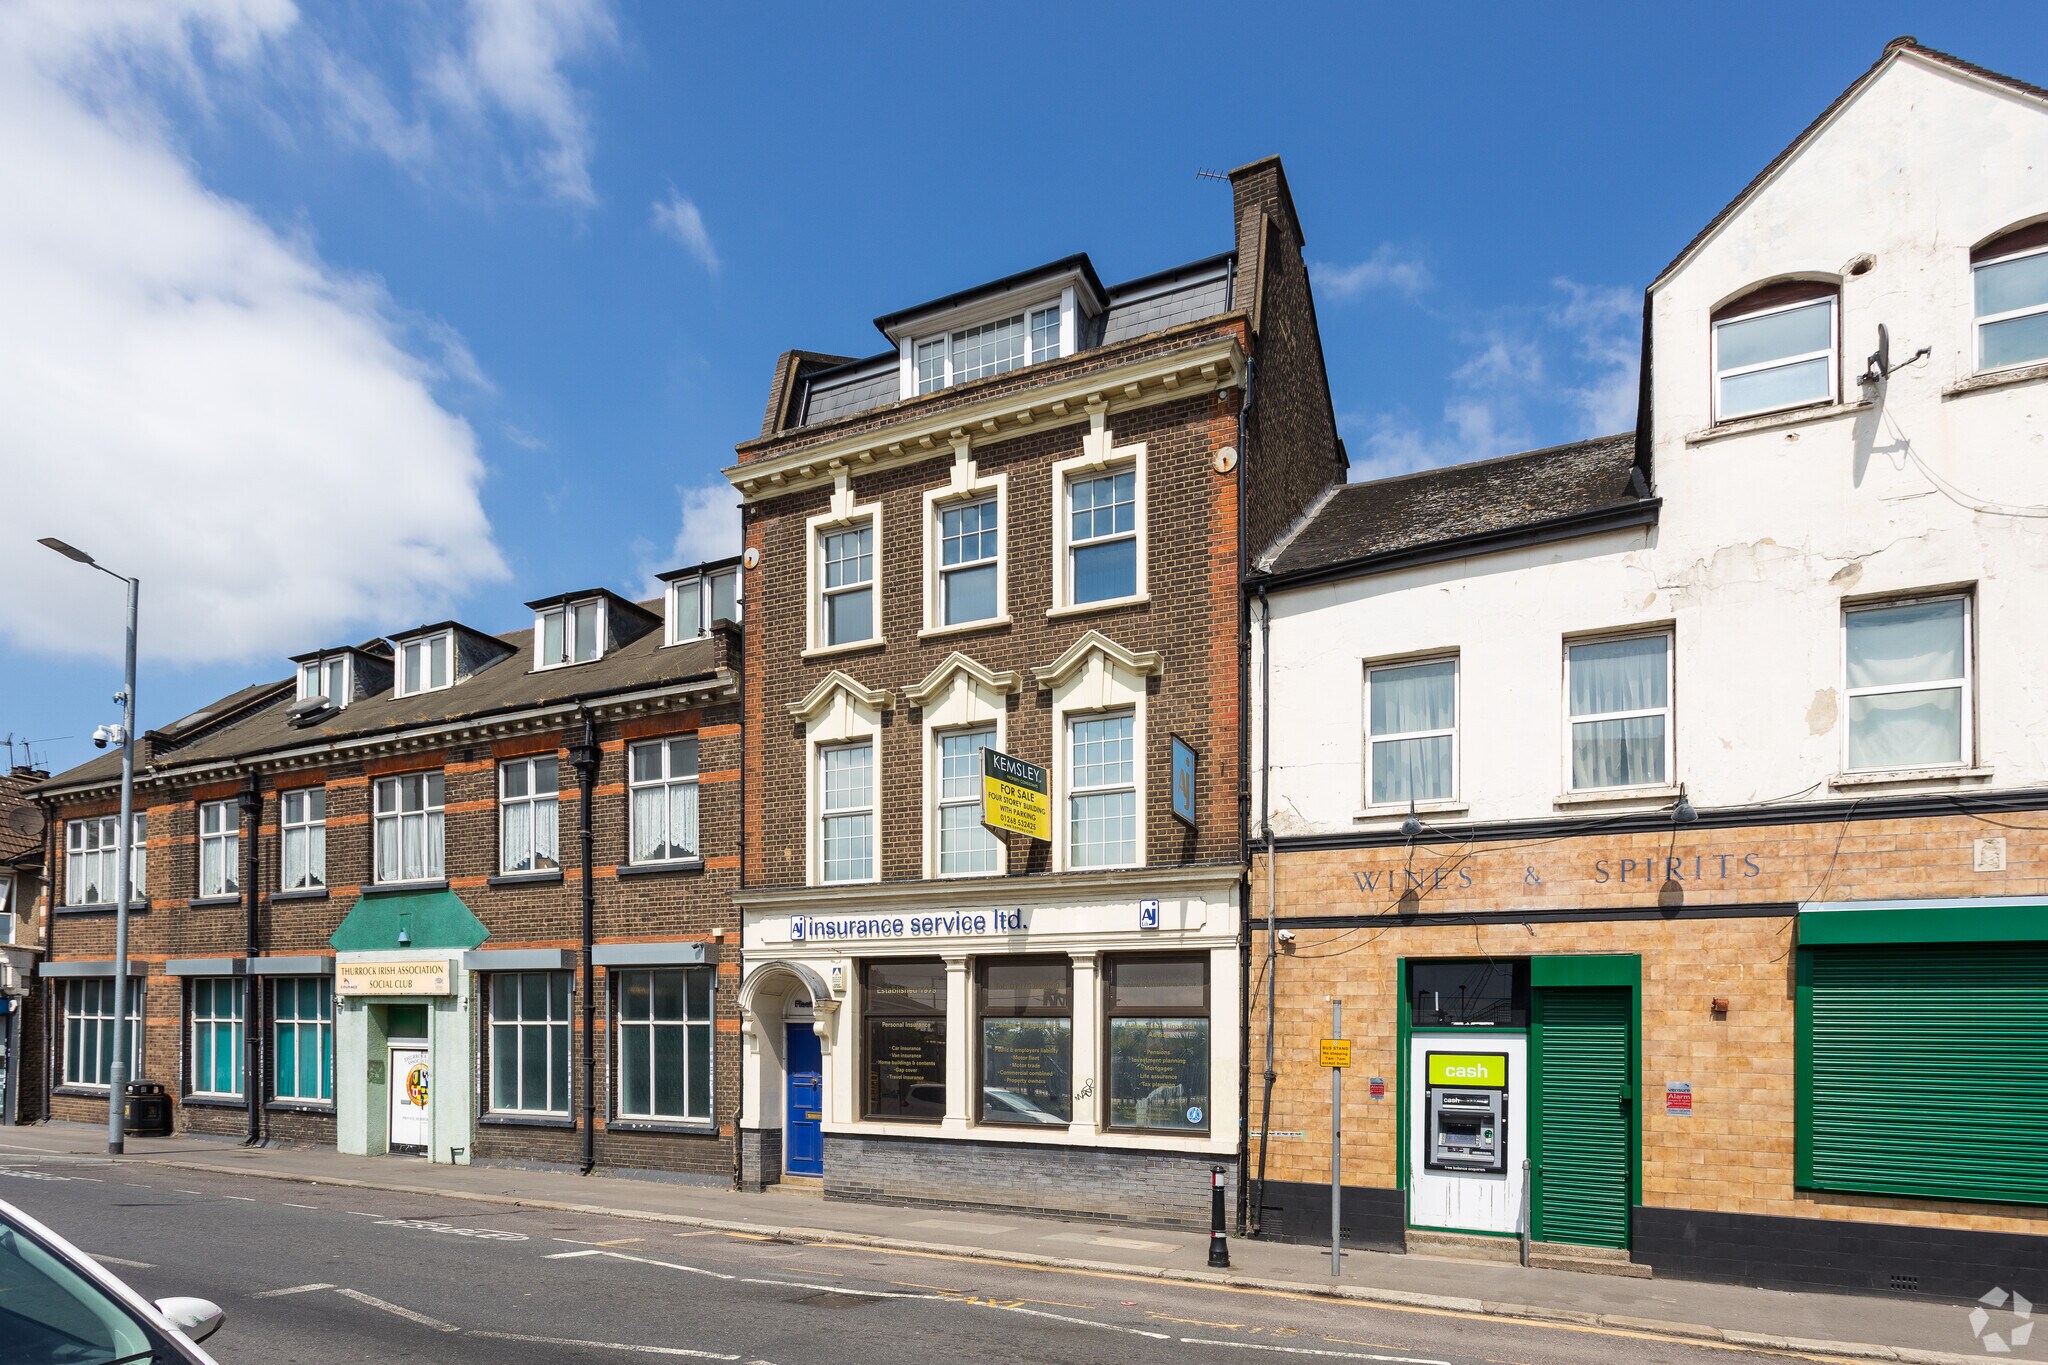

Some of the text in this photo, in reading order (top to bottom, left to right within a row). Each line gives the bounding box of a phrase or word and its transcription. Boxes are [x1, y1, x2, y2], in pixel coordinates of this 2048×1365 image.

[993, 754, 1040, 782] KEMSLEY
[1000, 784, 1034, 802] FOR SALE
[988, 792, 1046, 815] FOUR STOREY BUILDING
[1000, 804, 1037, 821] WITH PARKING
[1000, 814, 1036, 830] 01268 532425
[1353, 852, 1761, 893] WINES & SPIRITS
[809, 916, 904, 936] insurance
[910, 910, 986, 932] service
[994, 908, 1028, 929] ltd.
[341, 965, 443, 975] THURROCK IRISH ASSOCIATION
[369, 979, 413, 988] SOCIAL CLUB
[877, 986, 918, 994] Established
[1445, 1064, 1488, 1078] cash
